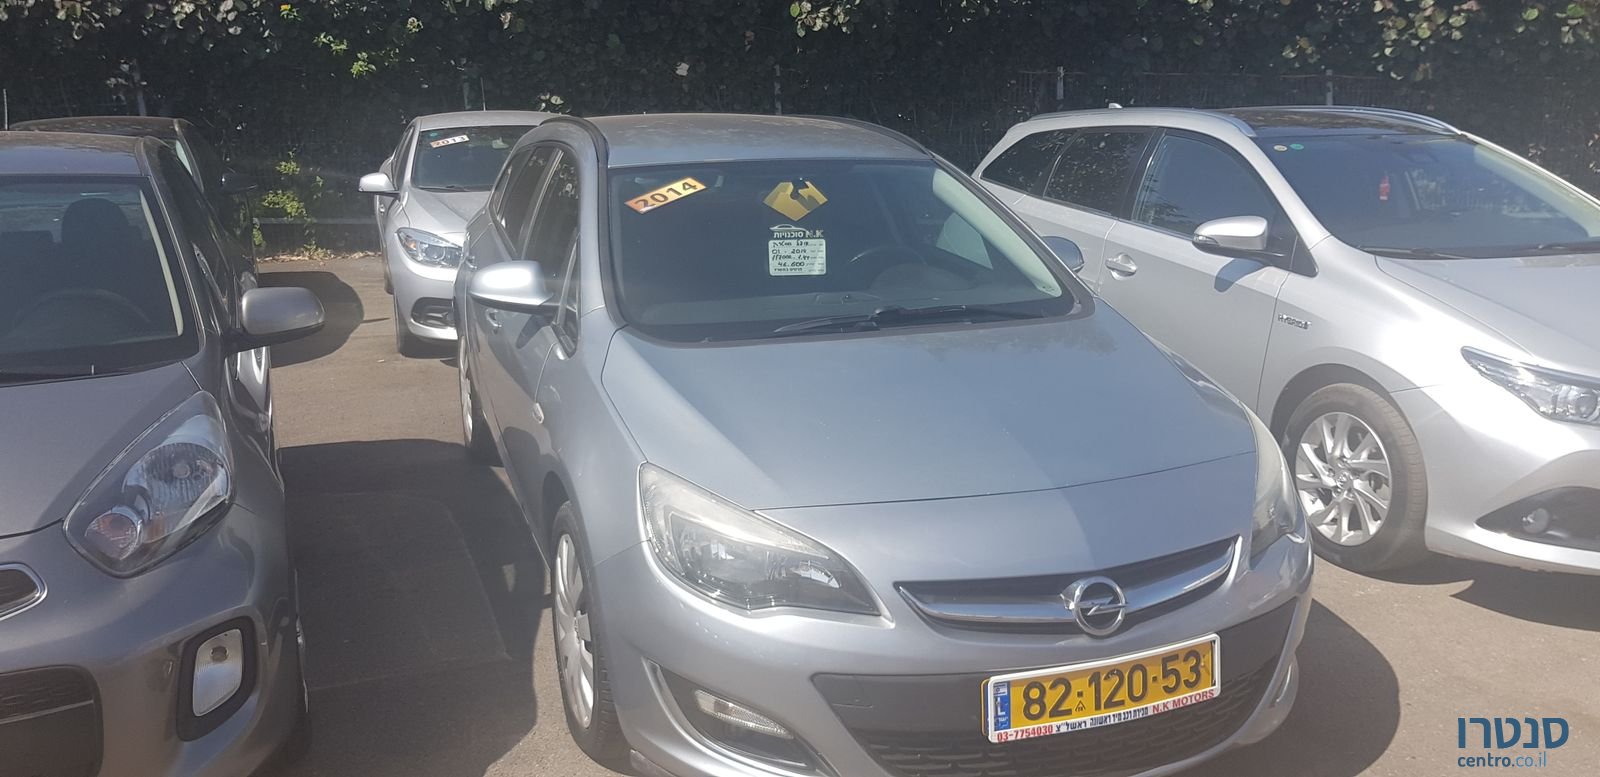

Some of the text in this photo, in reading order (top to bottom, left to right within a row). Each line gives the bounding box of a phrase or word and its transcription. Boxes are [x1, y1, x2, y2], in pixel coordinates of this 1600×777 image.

[633, 181, 699, 210] 2014
[1152, 688, 1215, 714] N.K MOTORS
[997, 724, 1054, 742] 03-7754030
